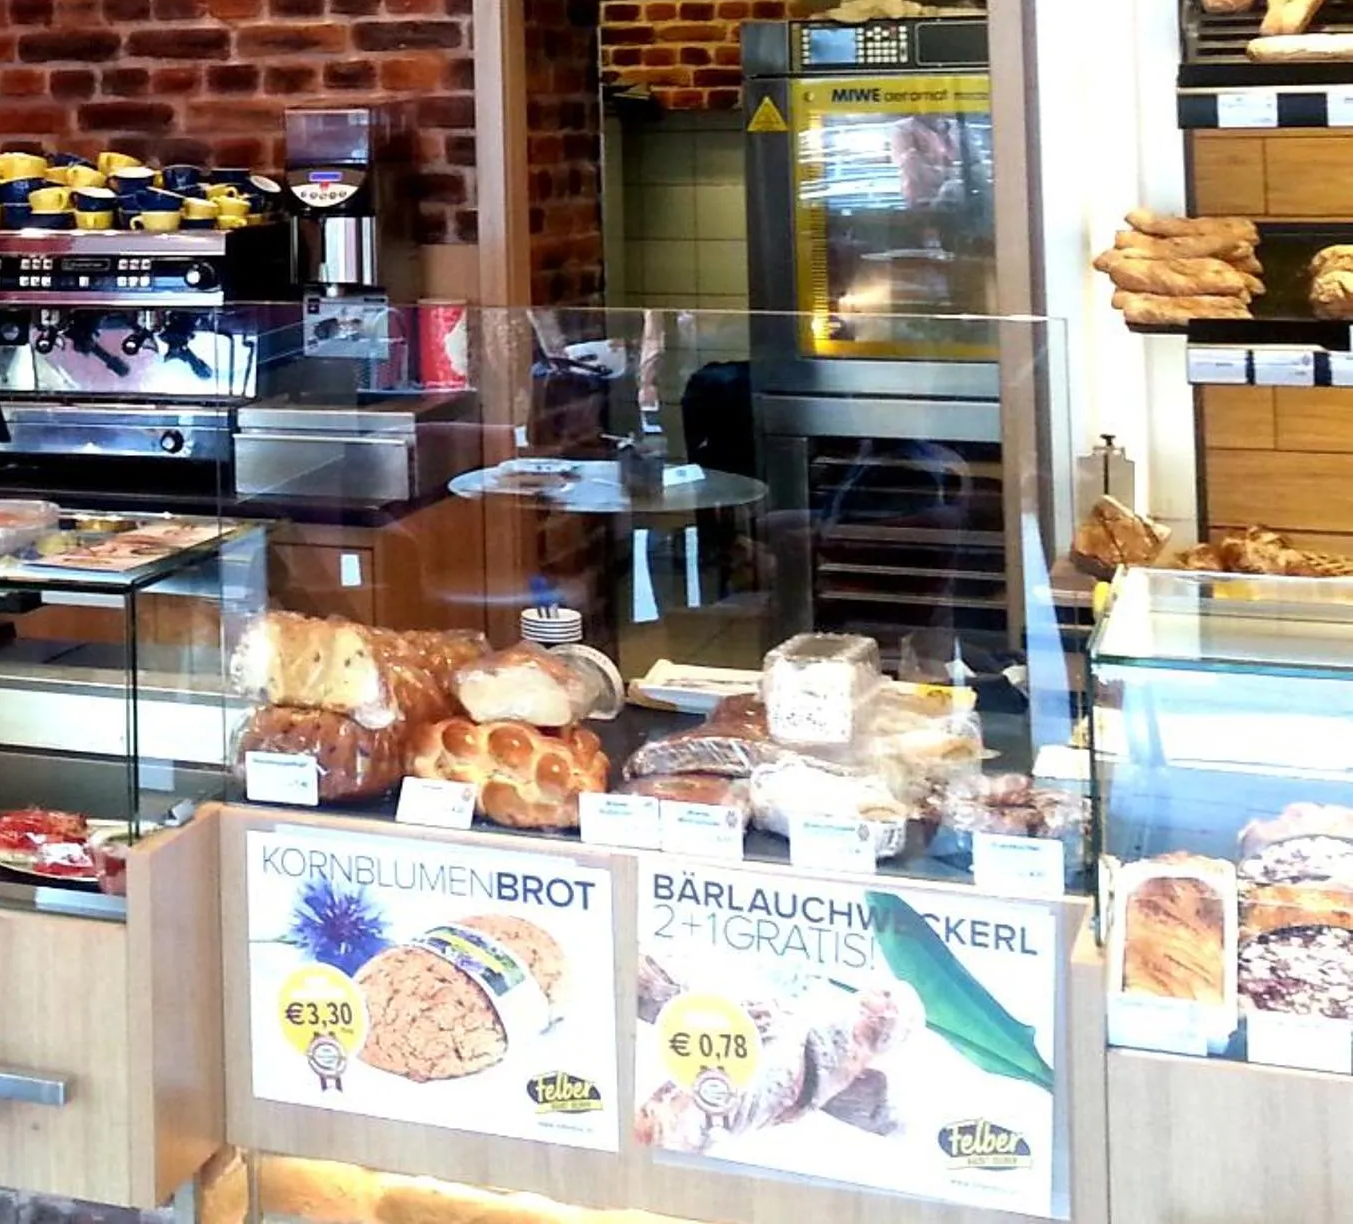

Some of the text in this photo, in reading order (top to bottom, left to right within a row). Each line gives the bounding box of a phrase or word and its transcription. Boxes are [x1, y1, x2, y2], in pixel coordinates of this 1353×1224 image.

[832, 88, 880, 103] MIWE
[262, 844, 596, 911] KORNBLUMENBROT
[653, 870, 1038, 956] BÄRLAUCHWKERL
[285, 1002, 353, 1029] €3,30
